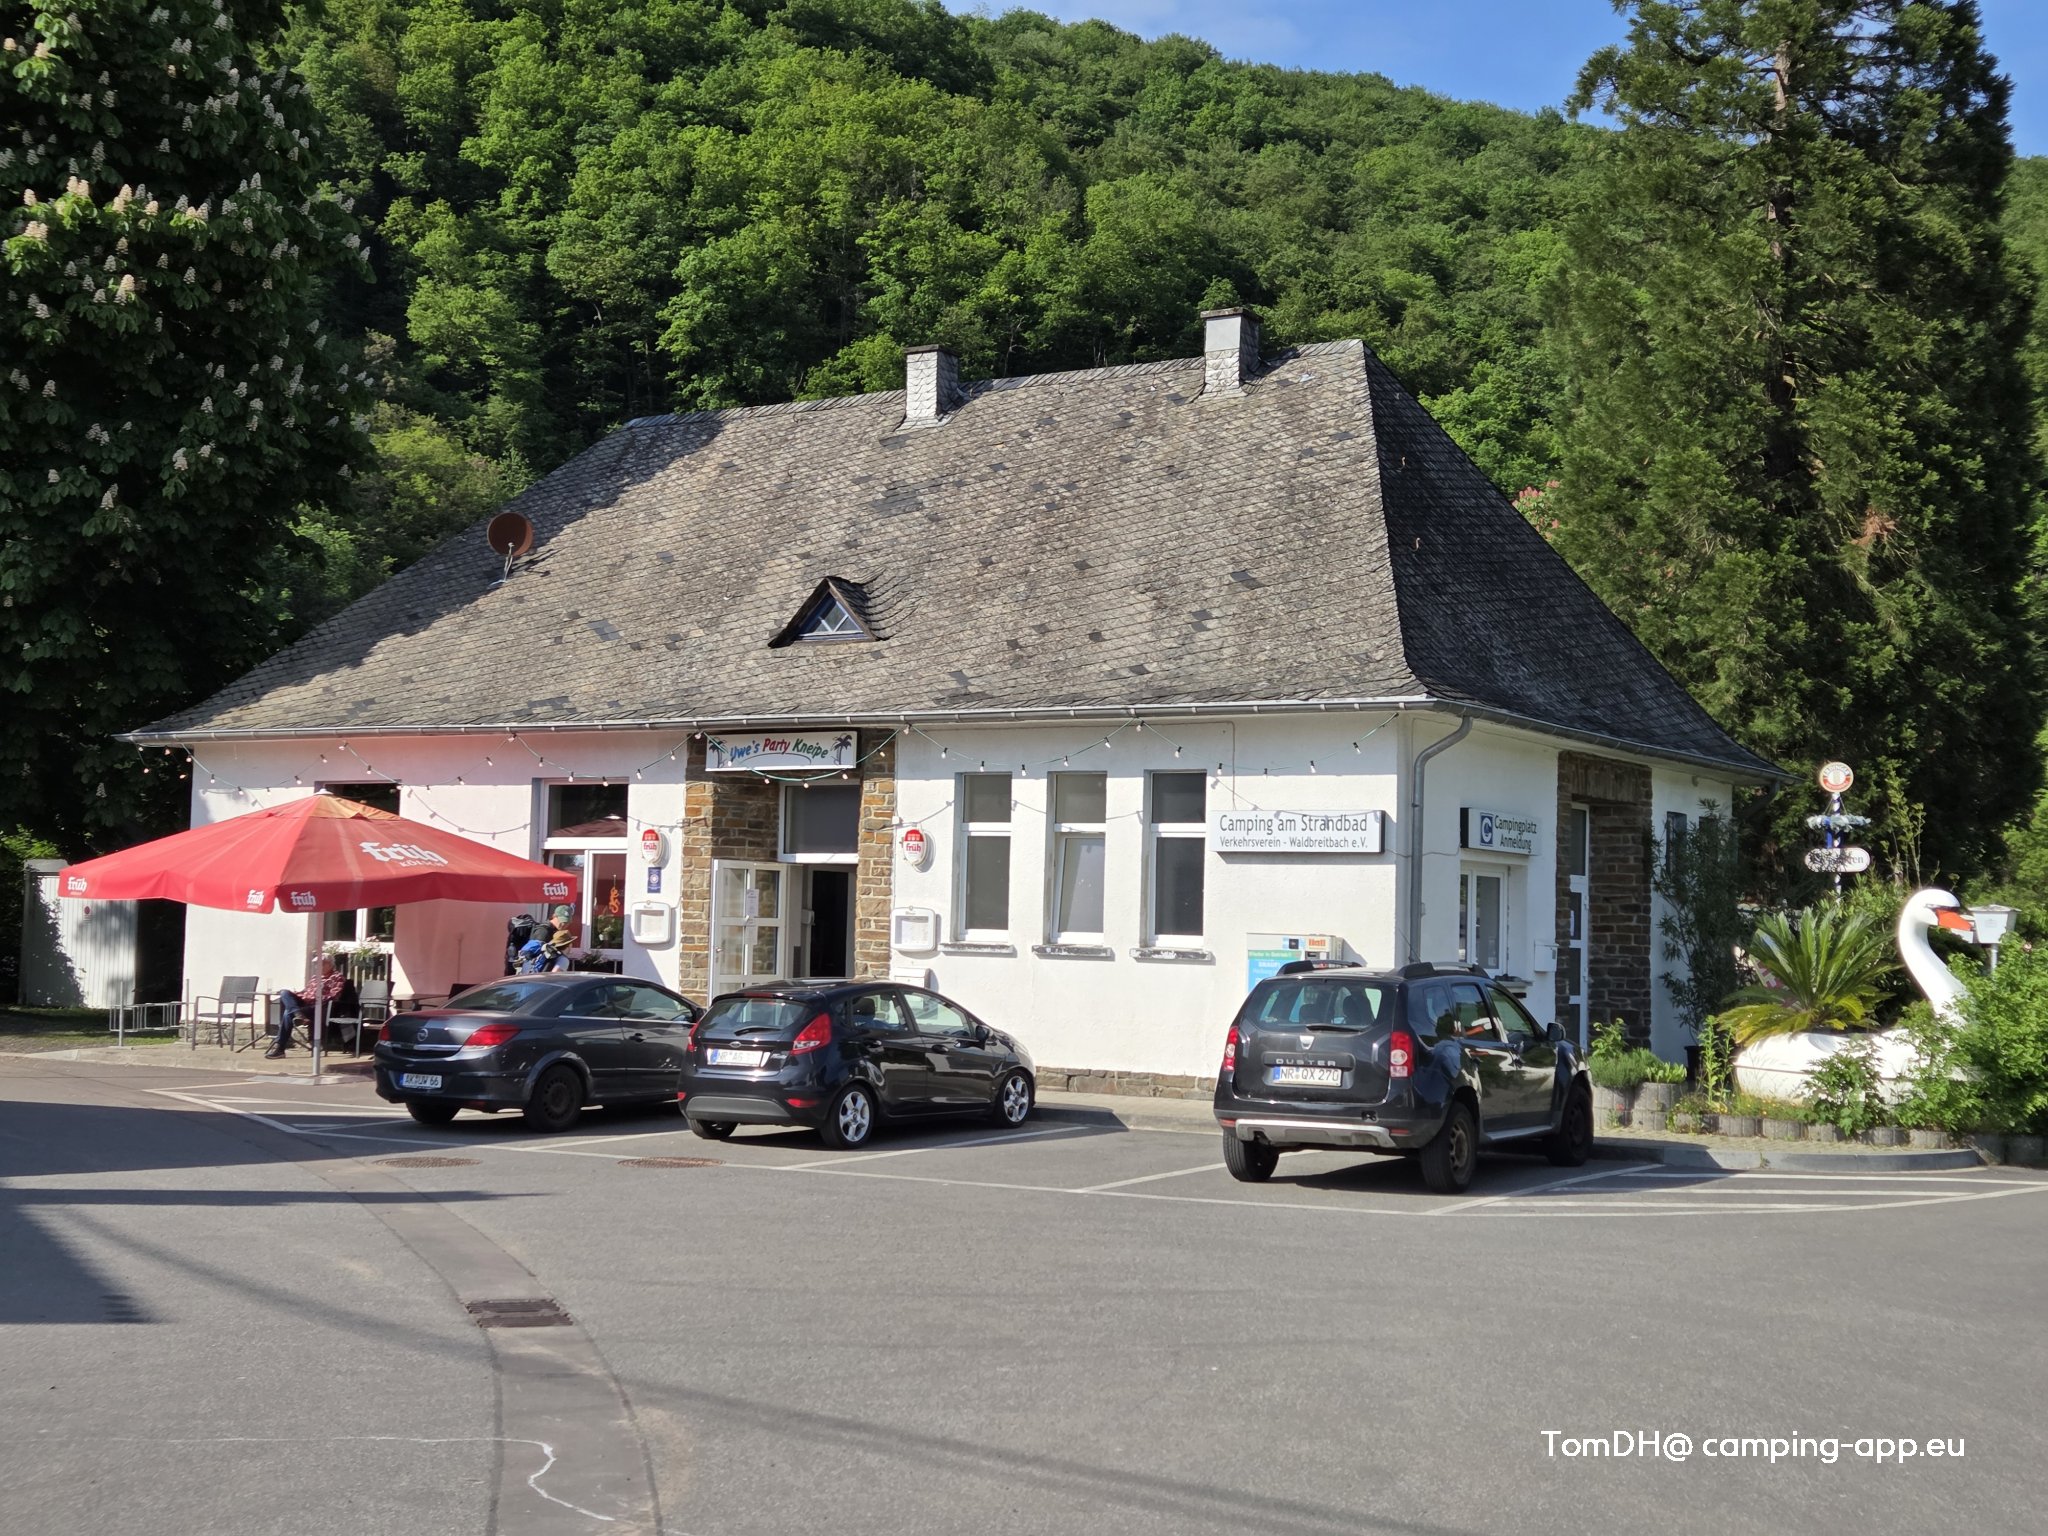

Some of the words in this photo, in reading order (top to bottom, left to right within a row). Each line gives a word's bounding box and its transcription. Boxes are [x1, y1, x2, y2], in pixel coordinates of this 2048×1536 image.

[730, 741, 760, 762] Uwe's
[762, 738, 791, 755] Party
[792, 738, 829, 759] Kneipe
[1219, 814, 1274, 836] Camping
[1277, 818, 1296, 832] am
[1301, 813, 1368, 832] Strandbad
[1494, 815, 1537, 836] Campingplatz
[643, 842, 657, 851] früh
[905, 842, 921, 853] früh
[1219, 836, 1281, 848] Verkehrsverein
[1289, 836, 1349, 848] Waldbreitbach
[1351, 836, 1368, 848] e.V.
[1500, 833, 1532, 854] Anmeldung
[359, 841, 449, 865] früh
[67, 876, 88, 892] früh
[541, 882, 568, 896] früh
[246, 889, 265, 906] früh
[290, 891, 317, 907] früh
[1275, 1058, 1336, 1067] DUSTER
[1280, 1068, 1295, 1080] NR
[1301, 1069, 1316, 1081] QX
[1318, 1069, 1339, 1082] 270
